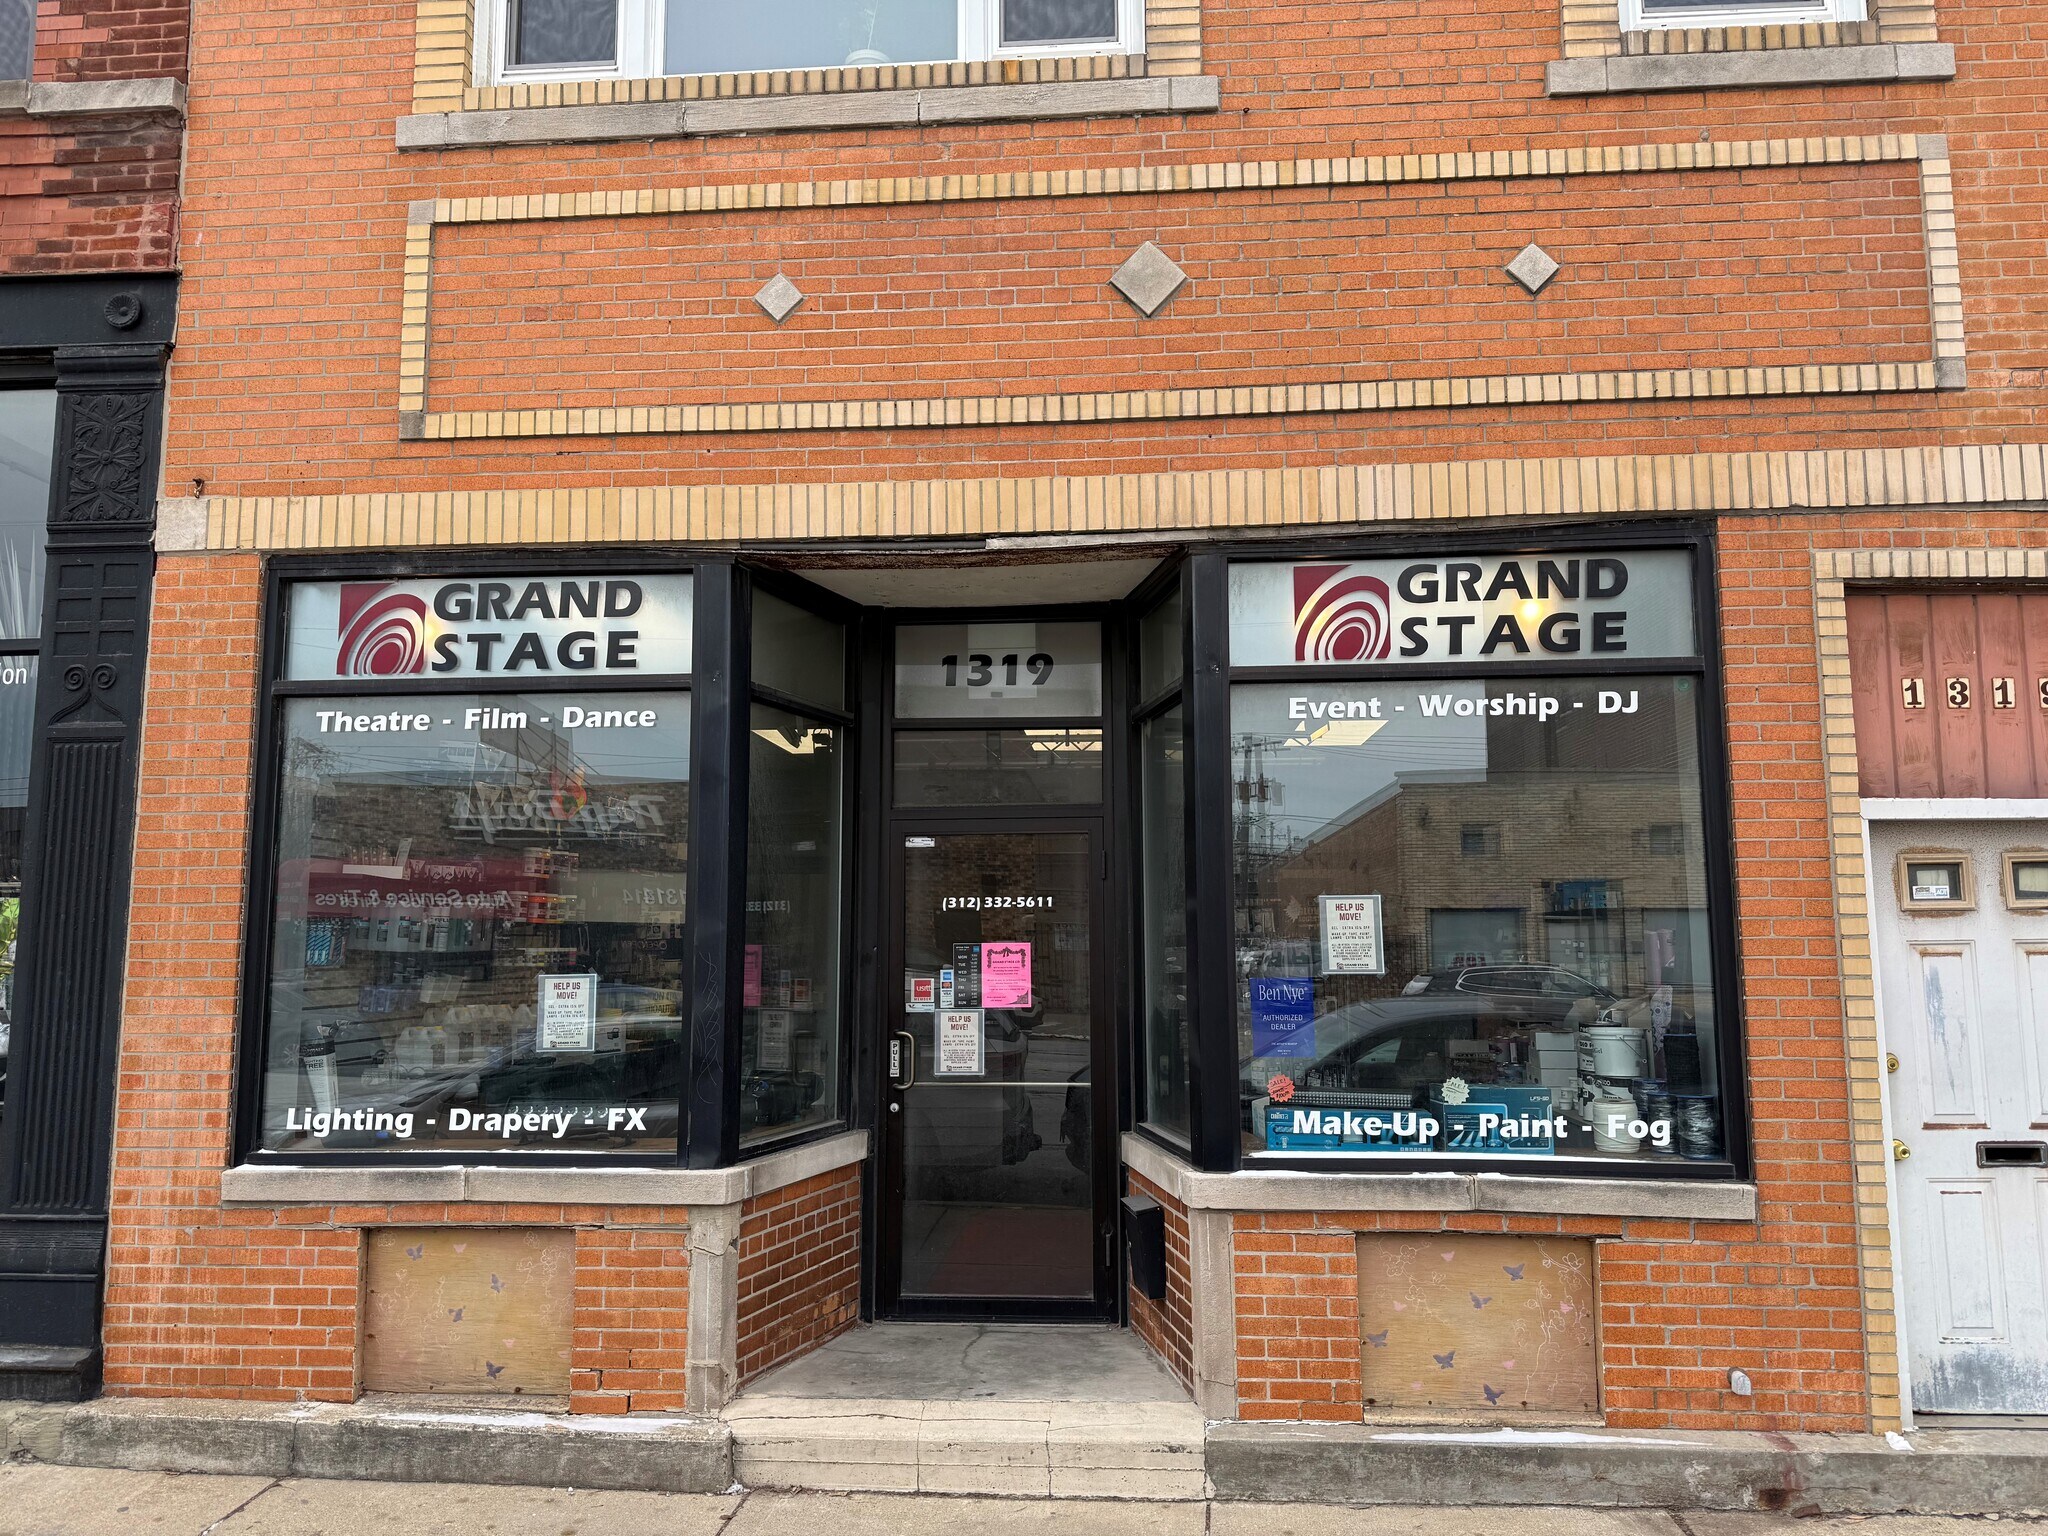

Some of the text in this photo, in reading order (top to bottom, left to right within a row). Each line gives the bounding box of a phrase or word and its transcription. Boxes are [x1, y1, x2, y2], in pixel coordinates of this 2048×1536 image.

[1397, 558, 1629, 604] GRAND
[433, 580, 643, 621] GRAND
[1399, 611, 1627, 657] STAGE
[431, 631, 639, 672] STAGE
[0, 662, 27, 685] on
[942, 653, 1054, 687] 1319
[315, 711, 432, 733] Theatre
[464, 707, 528, 730] Film
[561, 706, 657, 728] Dance
[1288, 696, 1382, 719] Event
[1418, 692, 1560, 722] Worship
[1598, 691, 1639, 715] DJ
[942, 896, 1053, 911] (312) 332-5611
[1335, 903, 1365, 911] HELP US
[1339, 913, 1362, 921] MOVE!
[553, 982, 581, 990] HELP US
[556, 991, 577, 1000] MOVE!
[1258, 984, 1305, 1005] Ben Nye
[947, 1015, 972, 1023] HELP US
[286, 1107, 414, 1138] Lighting
[448, 1108, 573, 1139] Drapery
[607, 1107, 648, 1131] FX
[1292, 1111, 1440, 1144] Make-Up
[1479, 1113, 1568, 1139] Paint
[1607, 1115, 1672, 1147] Fog
